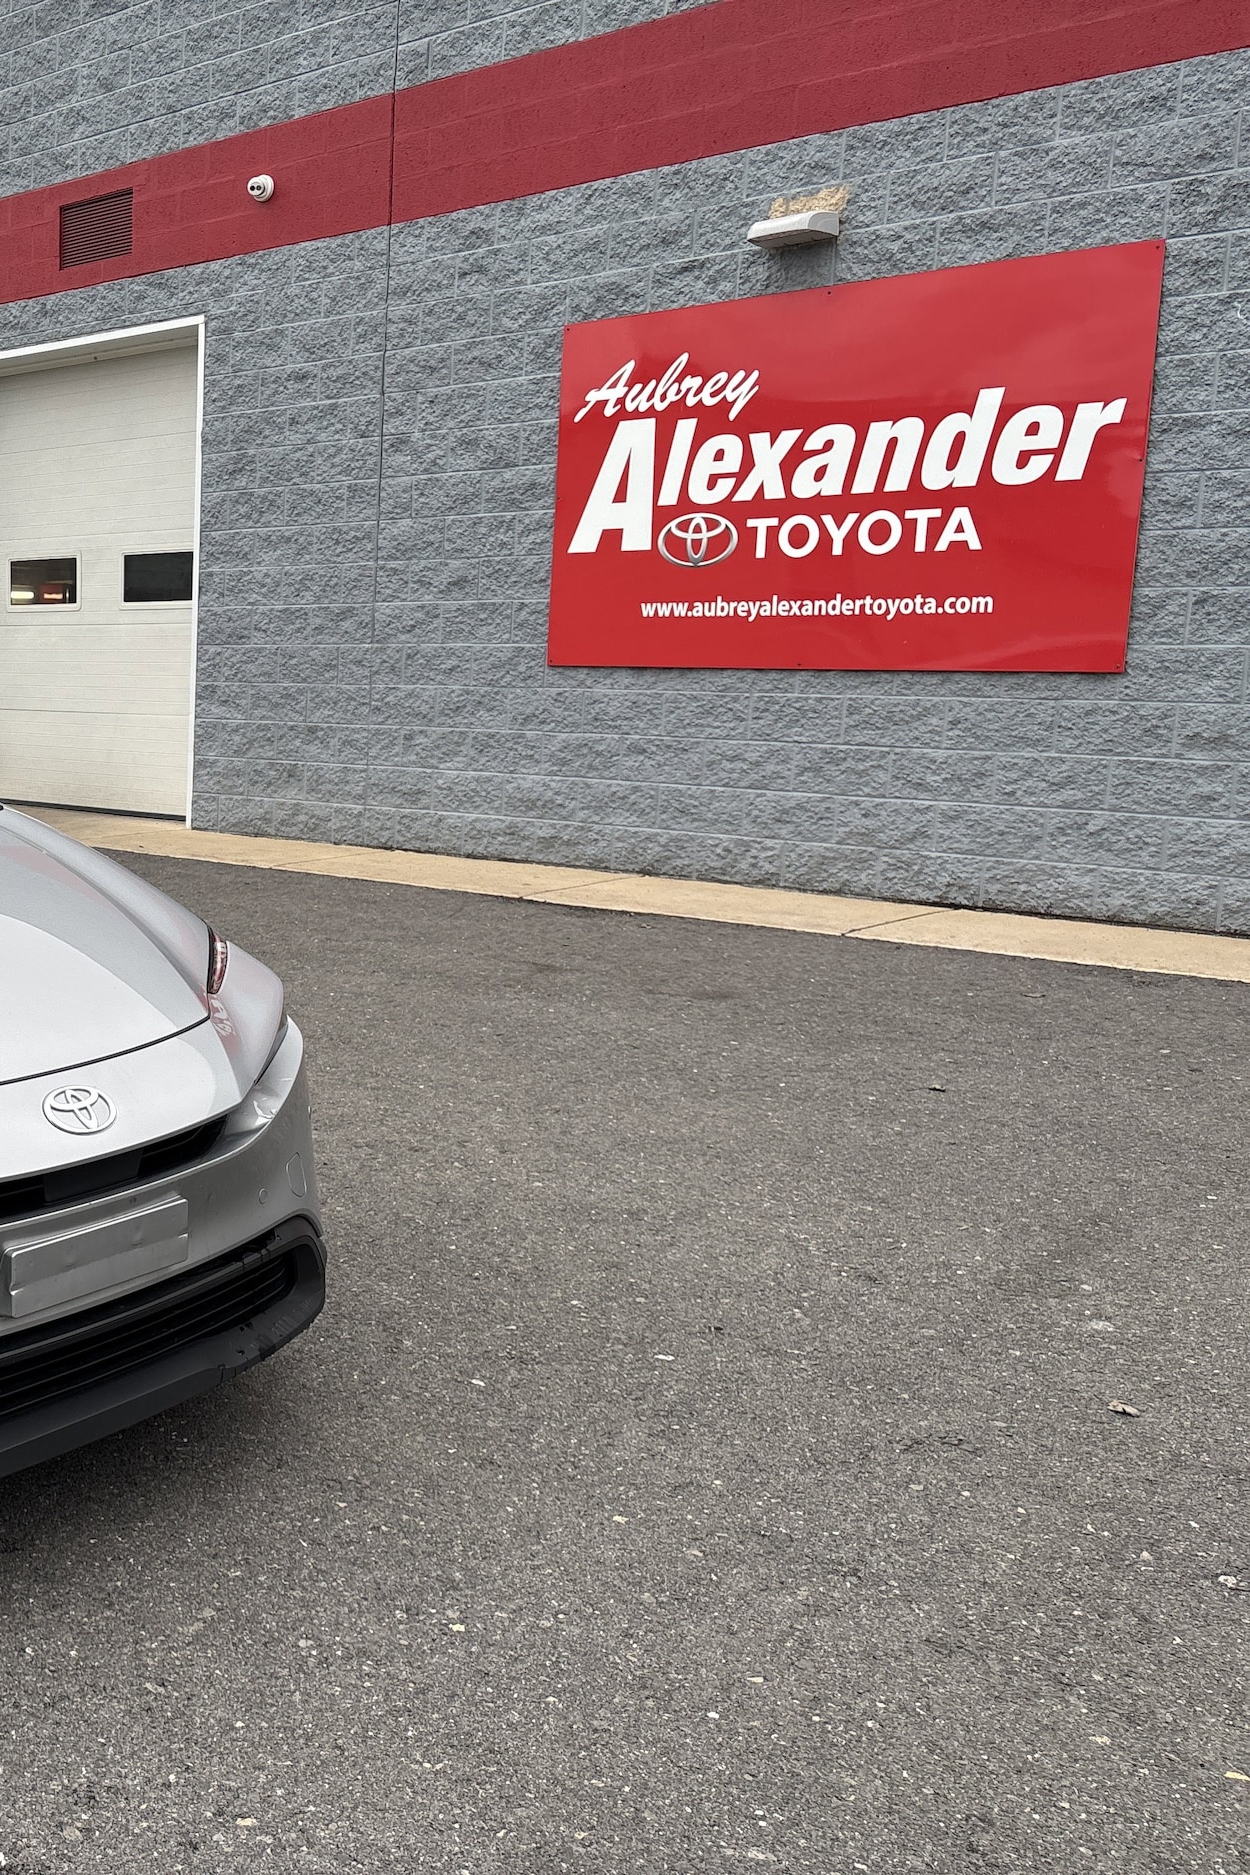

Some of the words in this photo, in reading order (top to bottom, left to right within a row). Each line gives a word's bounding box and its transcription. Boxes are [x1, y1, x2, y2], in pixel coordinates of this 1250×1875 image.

[573, 351, 760, 423] Aubrey
[566, 386, 1128, 554] Alexander
[746, 506, 983, 559] TOYOTA
[640, 593, 994, 622] www.aubreyalexandertoyota.com
